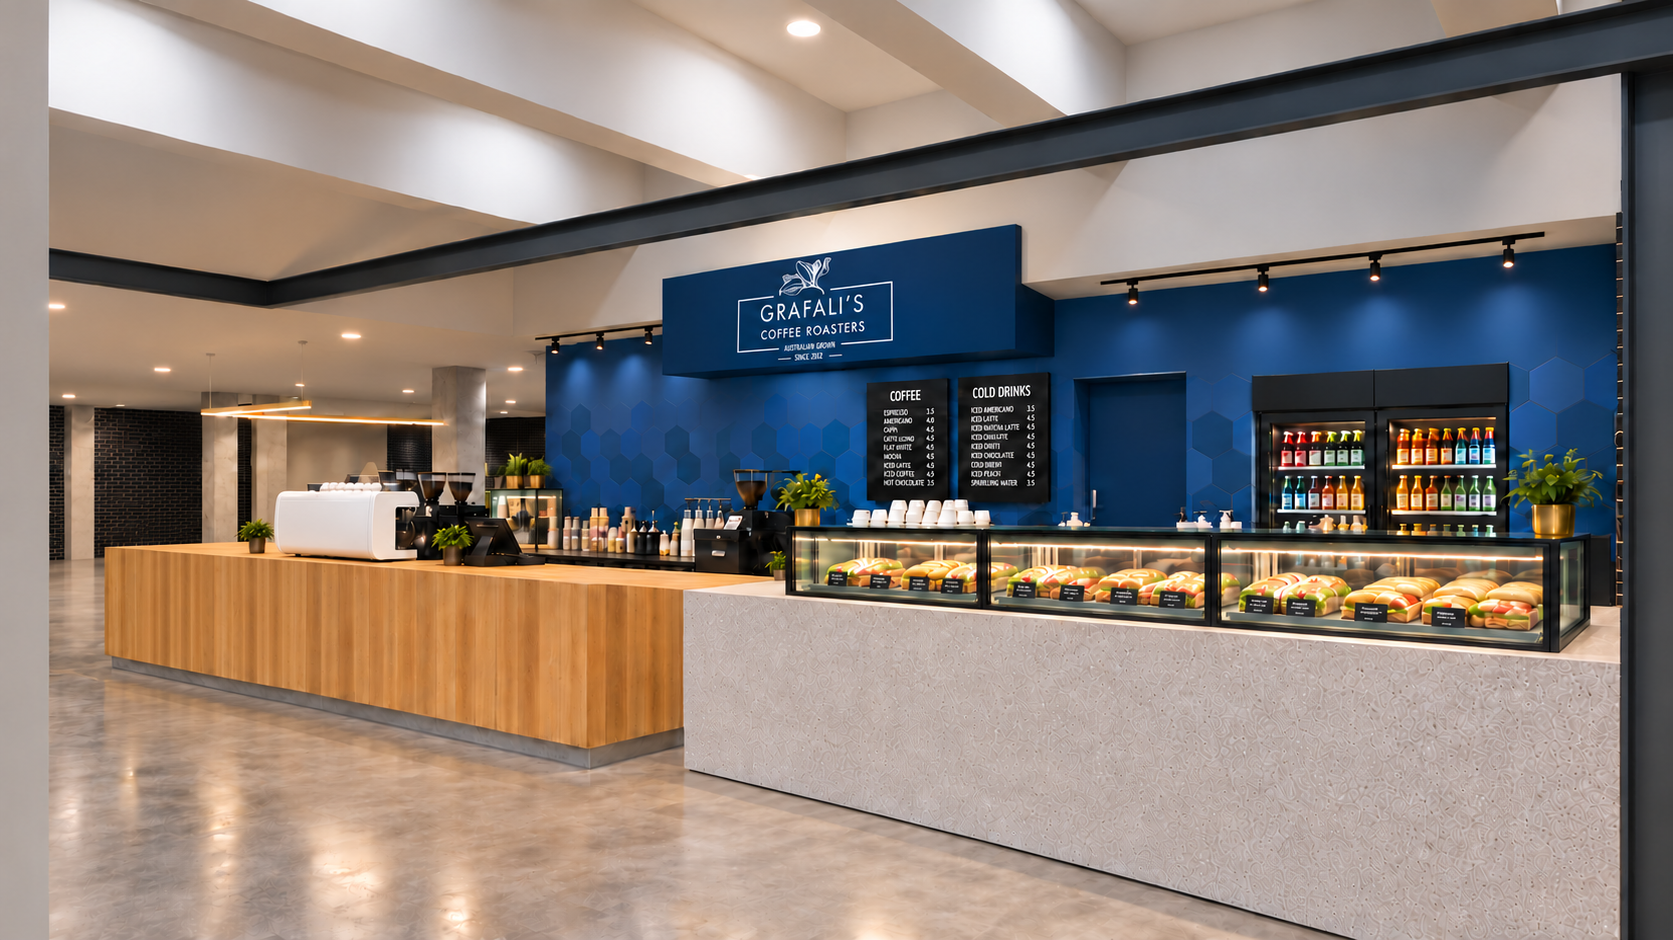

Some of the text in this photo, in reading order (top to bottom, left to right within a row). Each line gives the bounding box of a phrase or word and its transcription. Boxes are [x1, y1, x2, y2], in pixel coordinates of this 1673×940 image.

[760, 321, 865, 340] COFFEE ROASTERS
[890, 390, 921, 401] COFFEE
[972, 385, 1031, 398] COLD DRINKS
